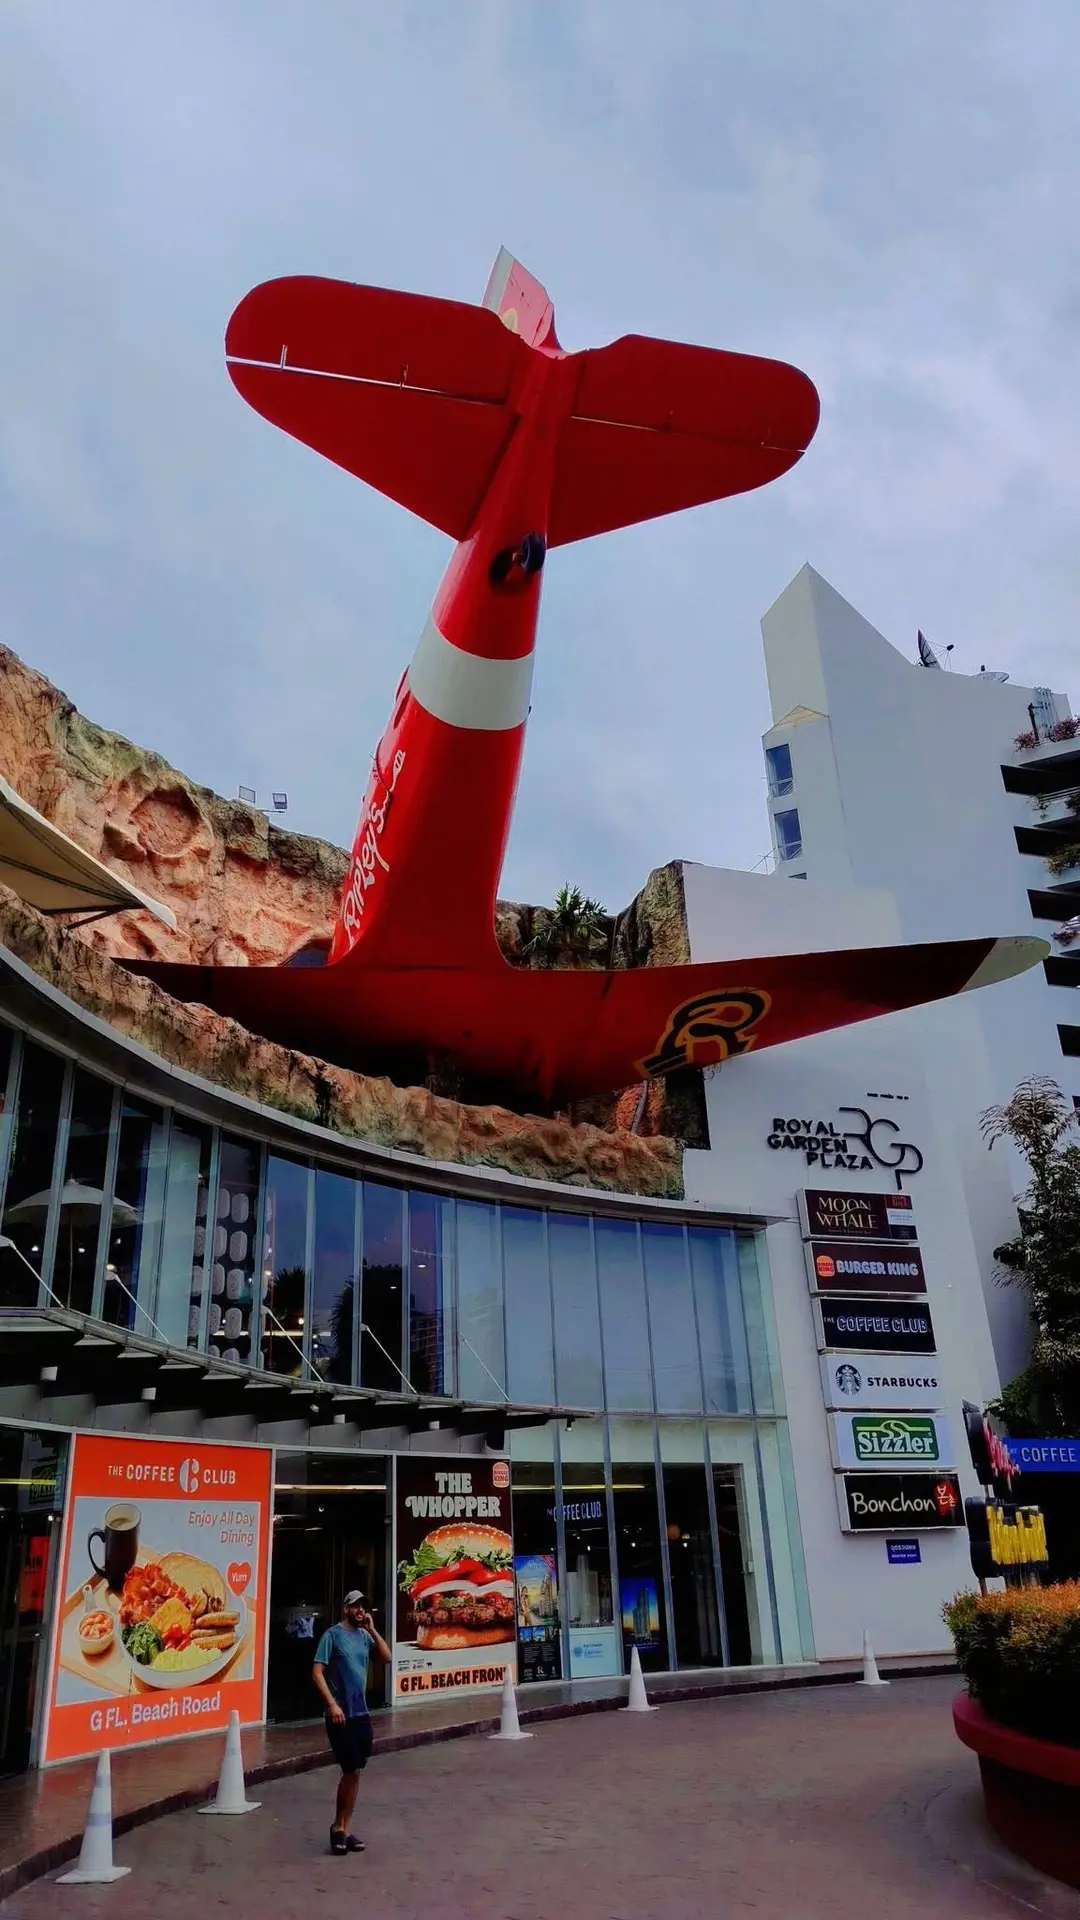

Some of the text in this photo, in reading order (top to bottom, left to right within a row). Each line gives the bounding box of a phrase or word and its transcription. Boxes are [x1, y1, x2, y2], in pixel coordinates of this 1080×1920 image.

[772, 1117, 841, 1137] ROYAL
[767, 1133, 848, 1153] GARDEN
[805, 1151, 874, 1170] PLAZA
[818, 1196, 872, 1213] MOON
[816, 1211, 879, 1229] WHALE
[835, 1259, 919, 1276] BURGER KING
[836, 1315, 891, 1333] COFFEE
[891, 1318, 928, 1334] CLUB
[867, 1377, 938, 1388] STARBUCKS
[857, 1431, 934, 1453] Sizzler
[1021, 1447, 1078, 1462] COFFEE
[107, 1465, 123, 1476] THE
[126, 1464, 175, 1482] COFFEE
[203, 1469, 236, 1485] CLUB
[435, 1472, 473, 1494] THE
[405, 1495, 501, 1518] WHOPPER
[553, 1503, 580, 1522] CFFEE
[581, 1501, 602, 1520] CLUB
[850, 1491, 937, 1515] Bonchon
[188, 1510, 255, 1527] Enjoy All Day
[220, 1530, 254, 1547] Dining
[231, 1572, 248, 1582] Yum
[400, 1677, 409, 1693] G
[410, 1676, 429, 1692] FL.
[430, 1670, 471, 1690] BEACH
[472, 1666, 507, 1684] FRON
[90, 1690, 221, 1731] G FL. Beach Road
